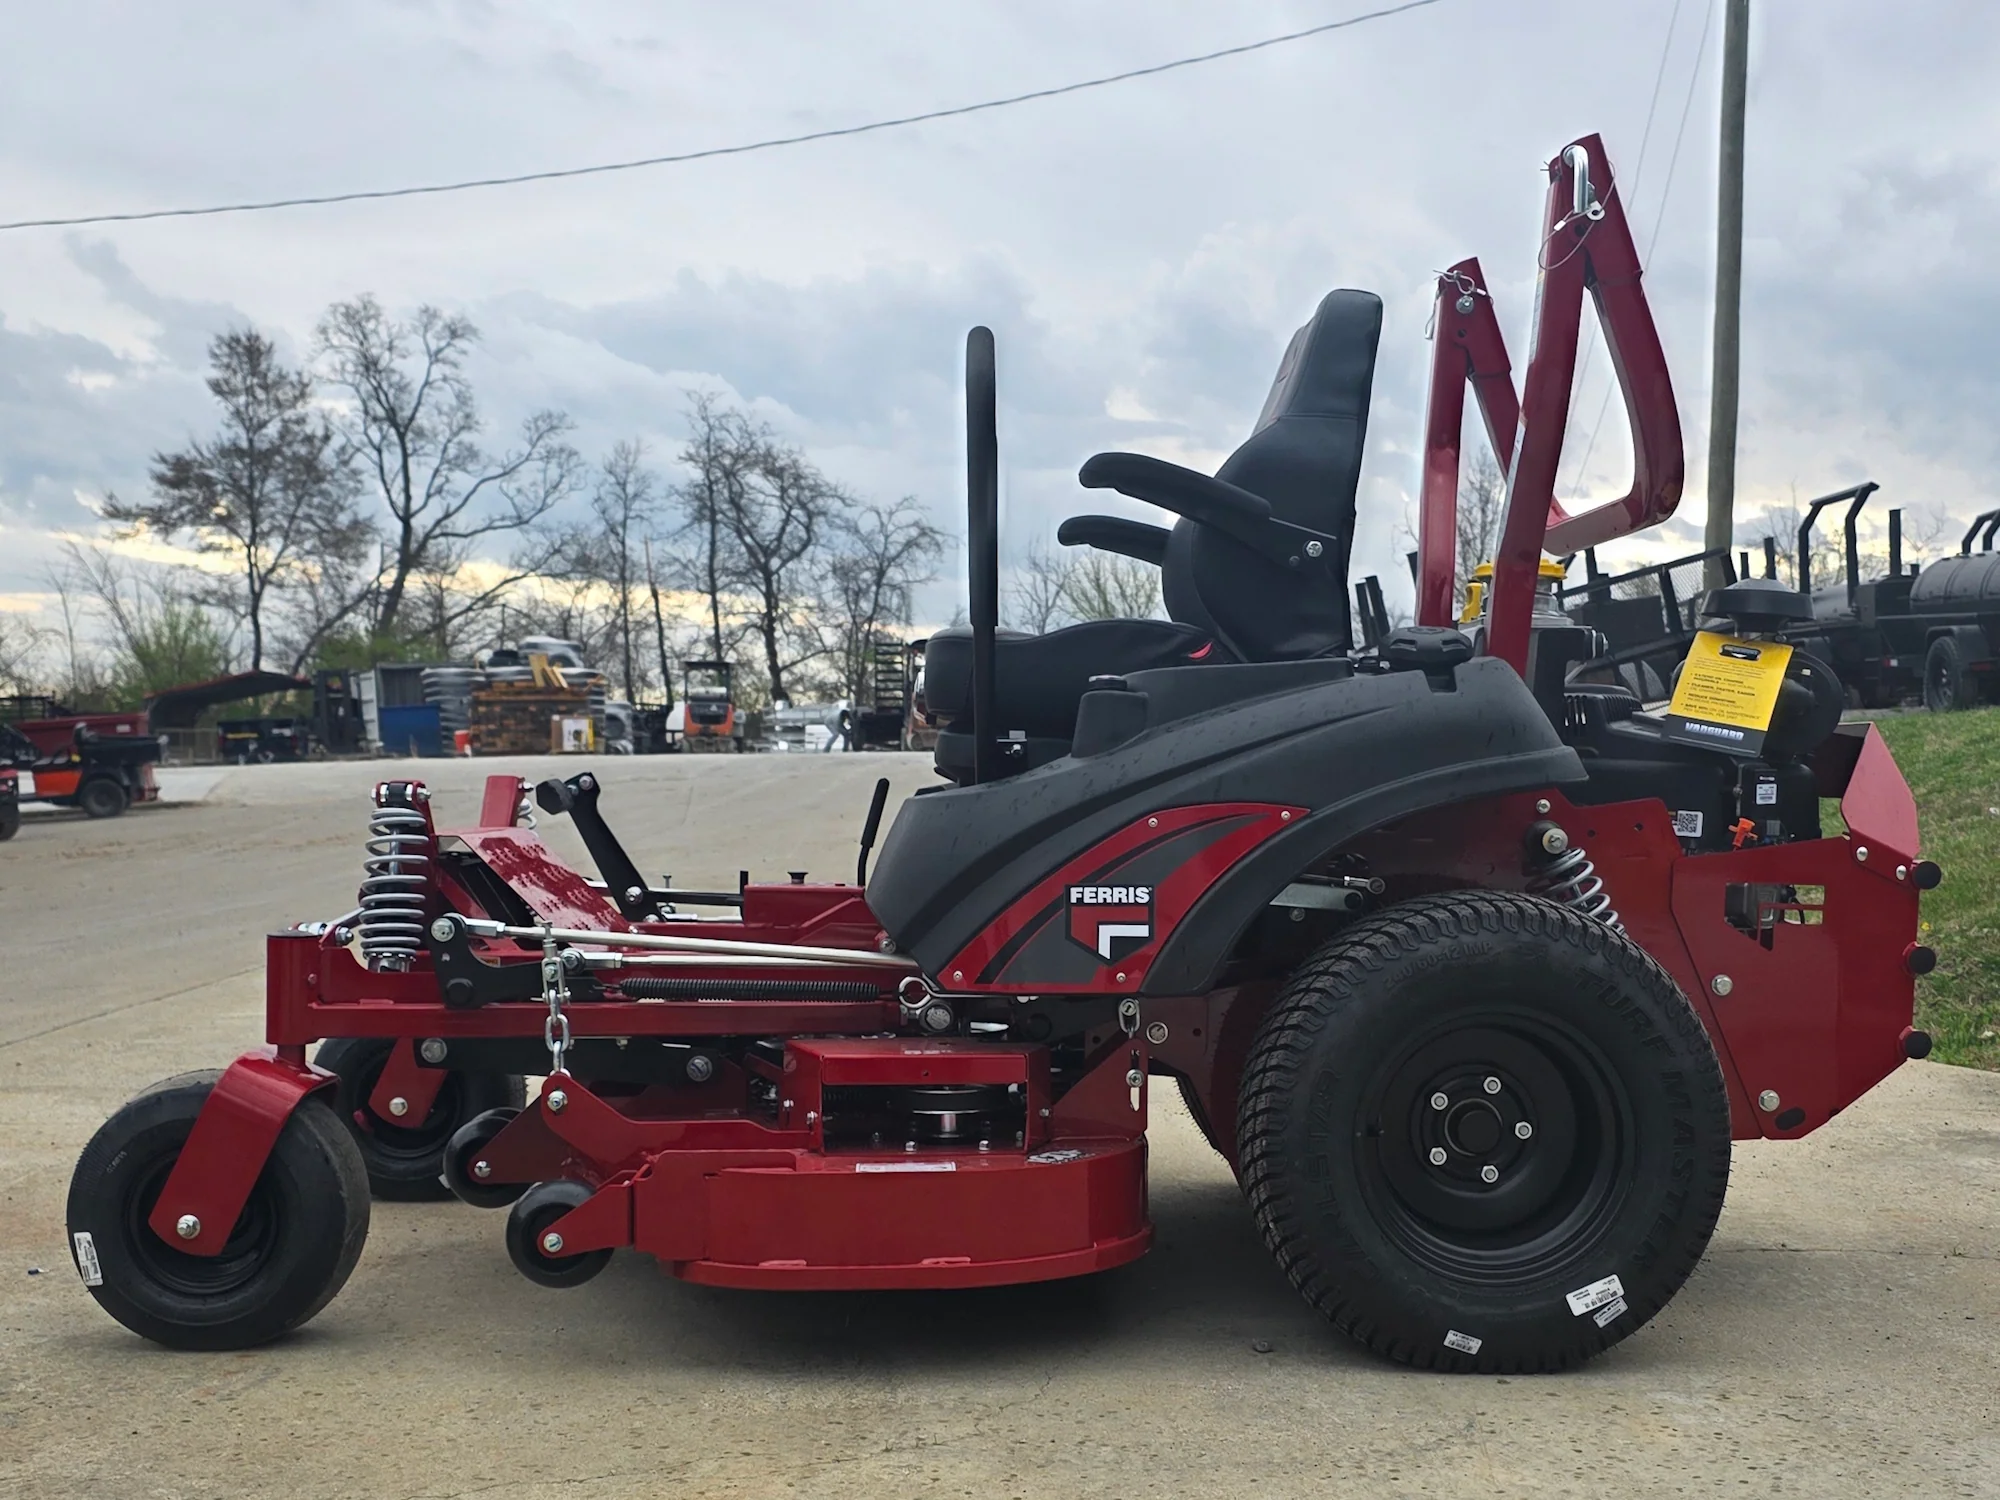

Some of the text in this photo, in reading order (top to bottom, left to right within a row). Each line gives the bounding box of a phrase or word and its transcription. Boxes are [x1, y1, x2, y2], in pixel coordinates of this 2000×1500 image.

[1686, 722, 1744, 740] VANGUARD
[1070, 887, 1150, 904] FERRIS
[1464, 940, 1493, 955] IMP
[1574, 966, 1694, 1267] TURF MASTER
